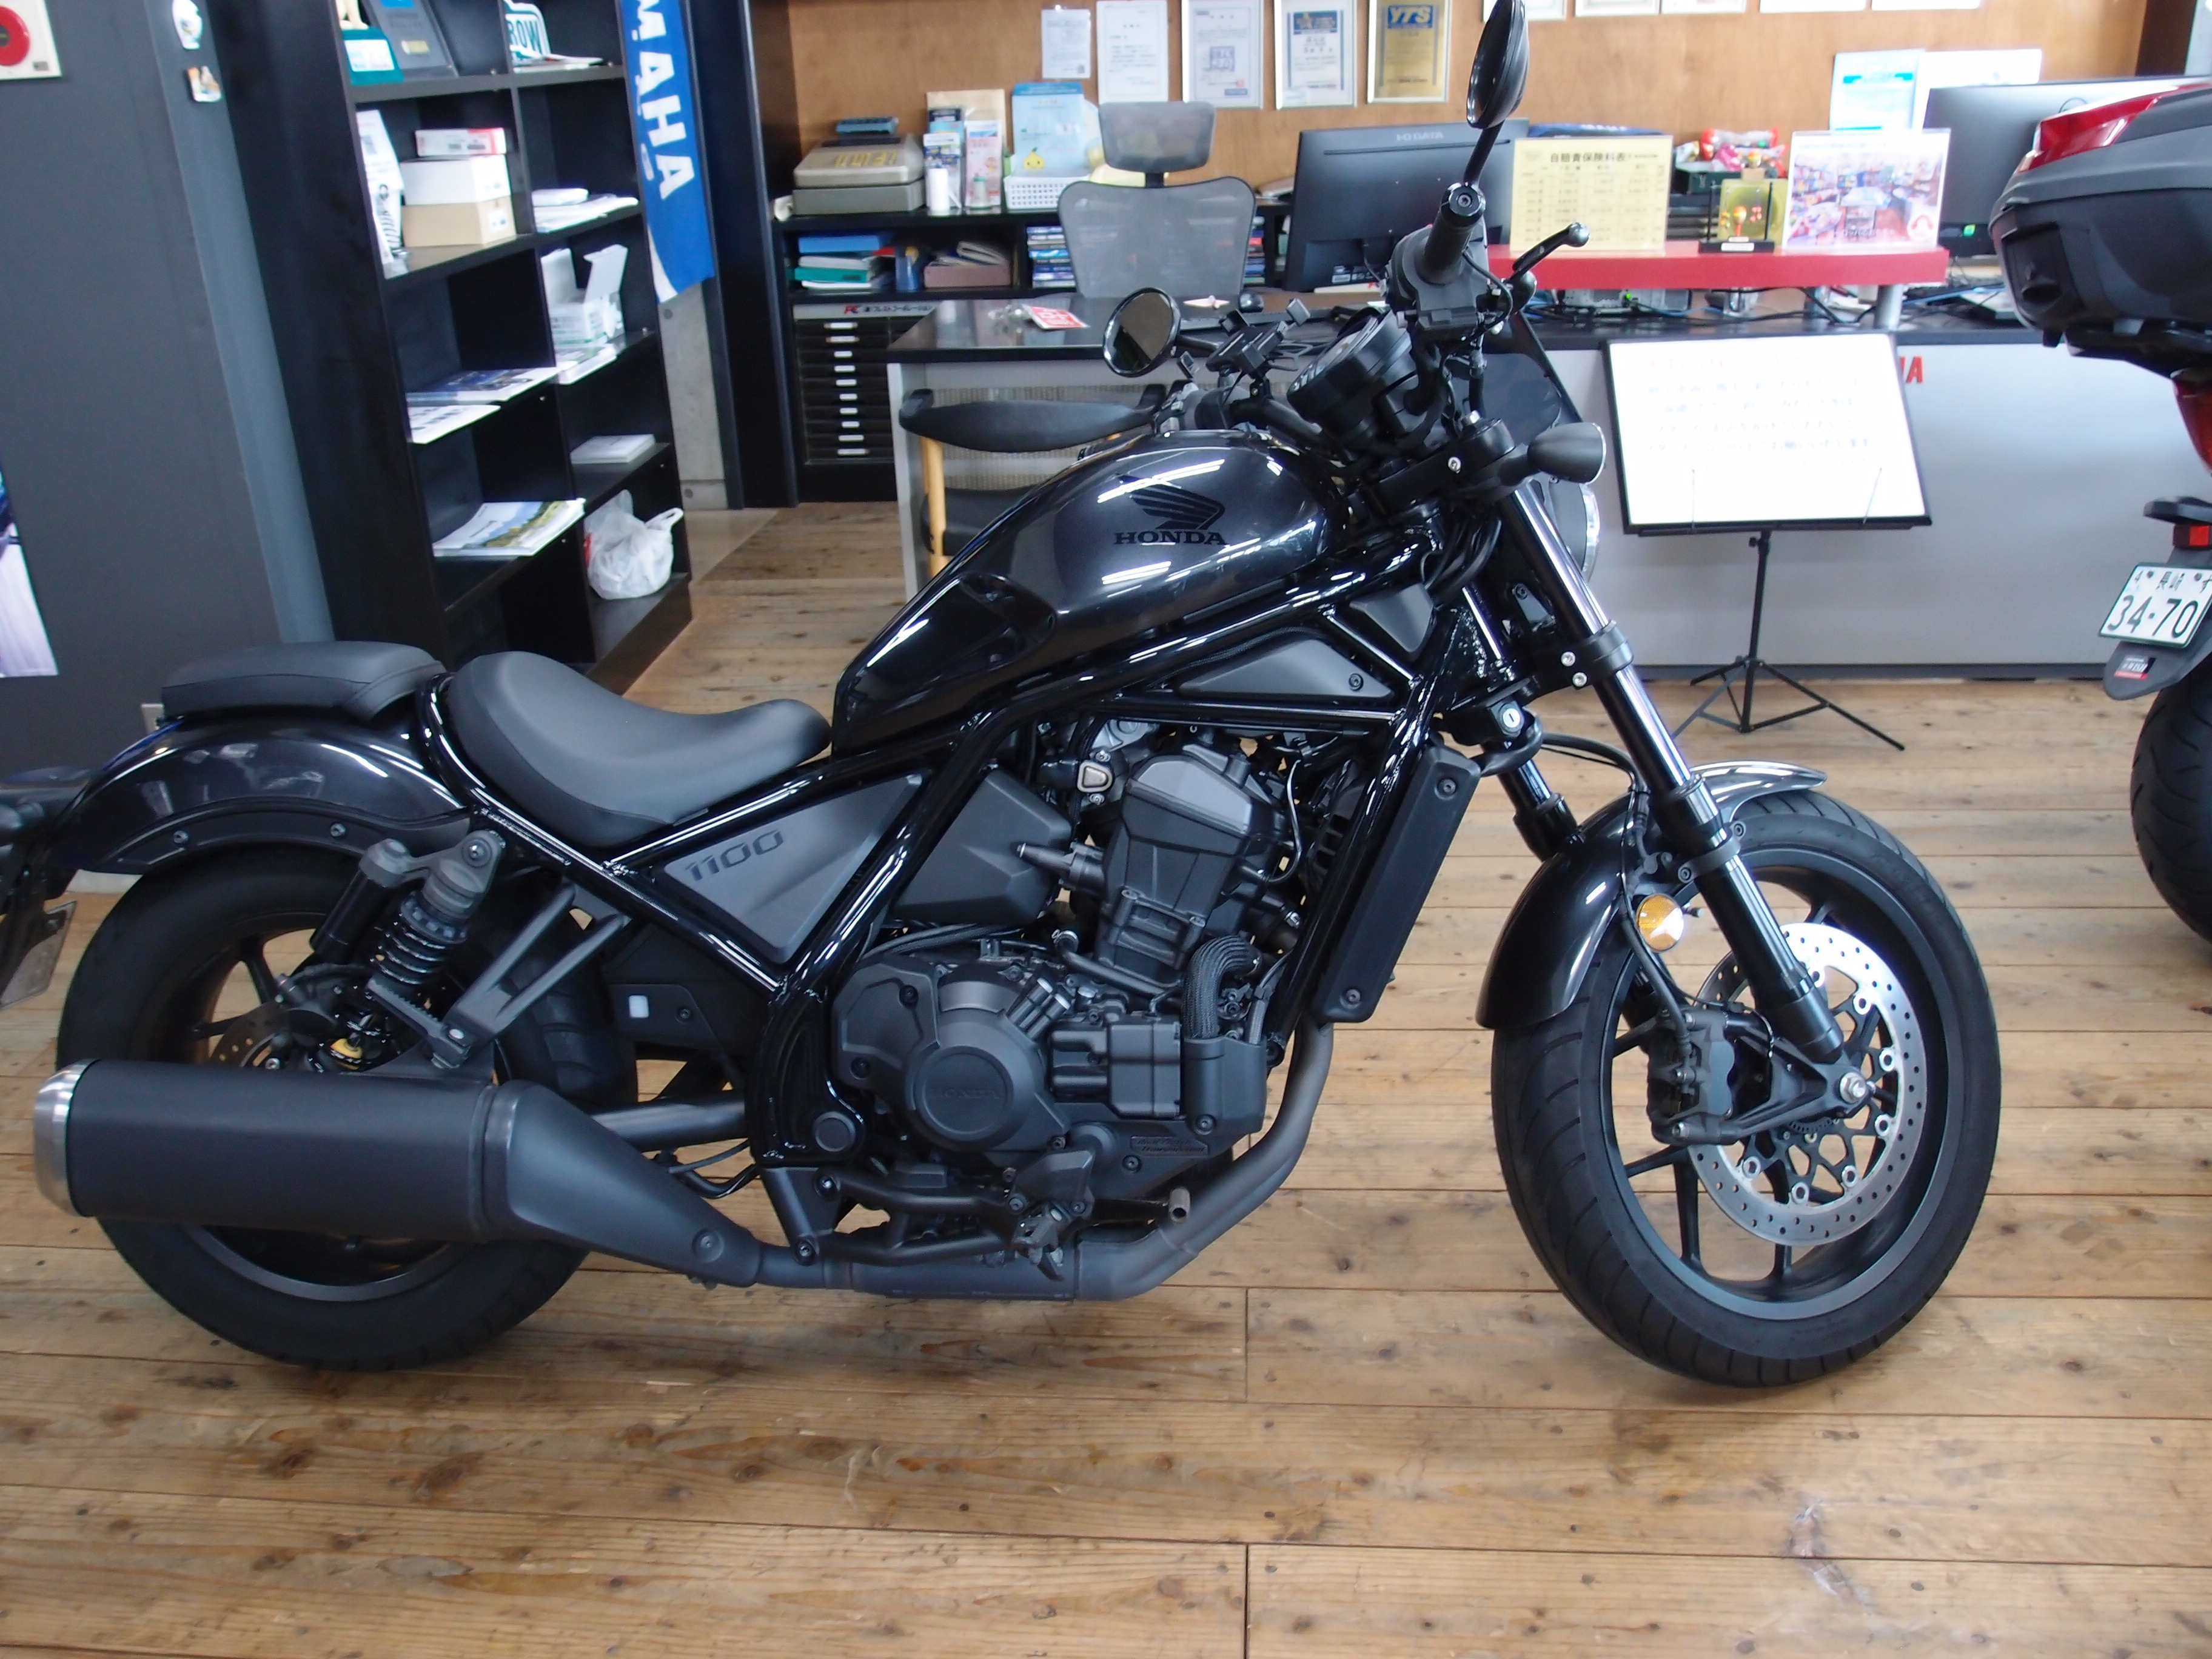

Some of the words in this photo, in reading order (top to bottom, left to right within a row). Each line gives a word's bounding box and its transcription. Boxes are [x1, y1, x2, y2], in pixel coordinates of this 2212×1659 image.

[1114, 531, 1227, 545] HONDA
[2156, 571, 2185, 591] 長崎
[685, 830, 783, 881] 1100
